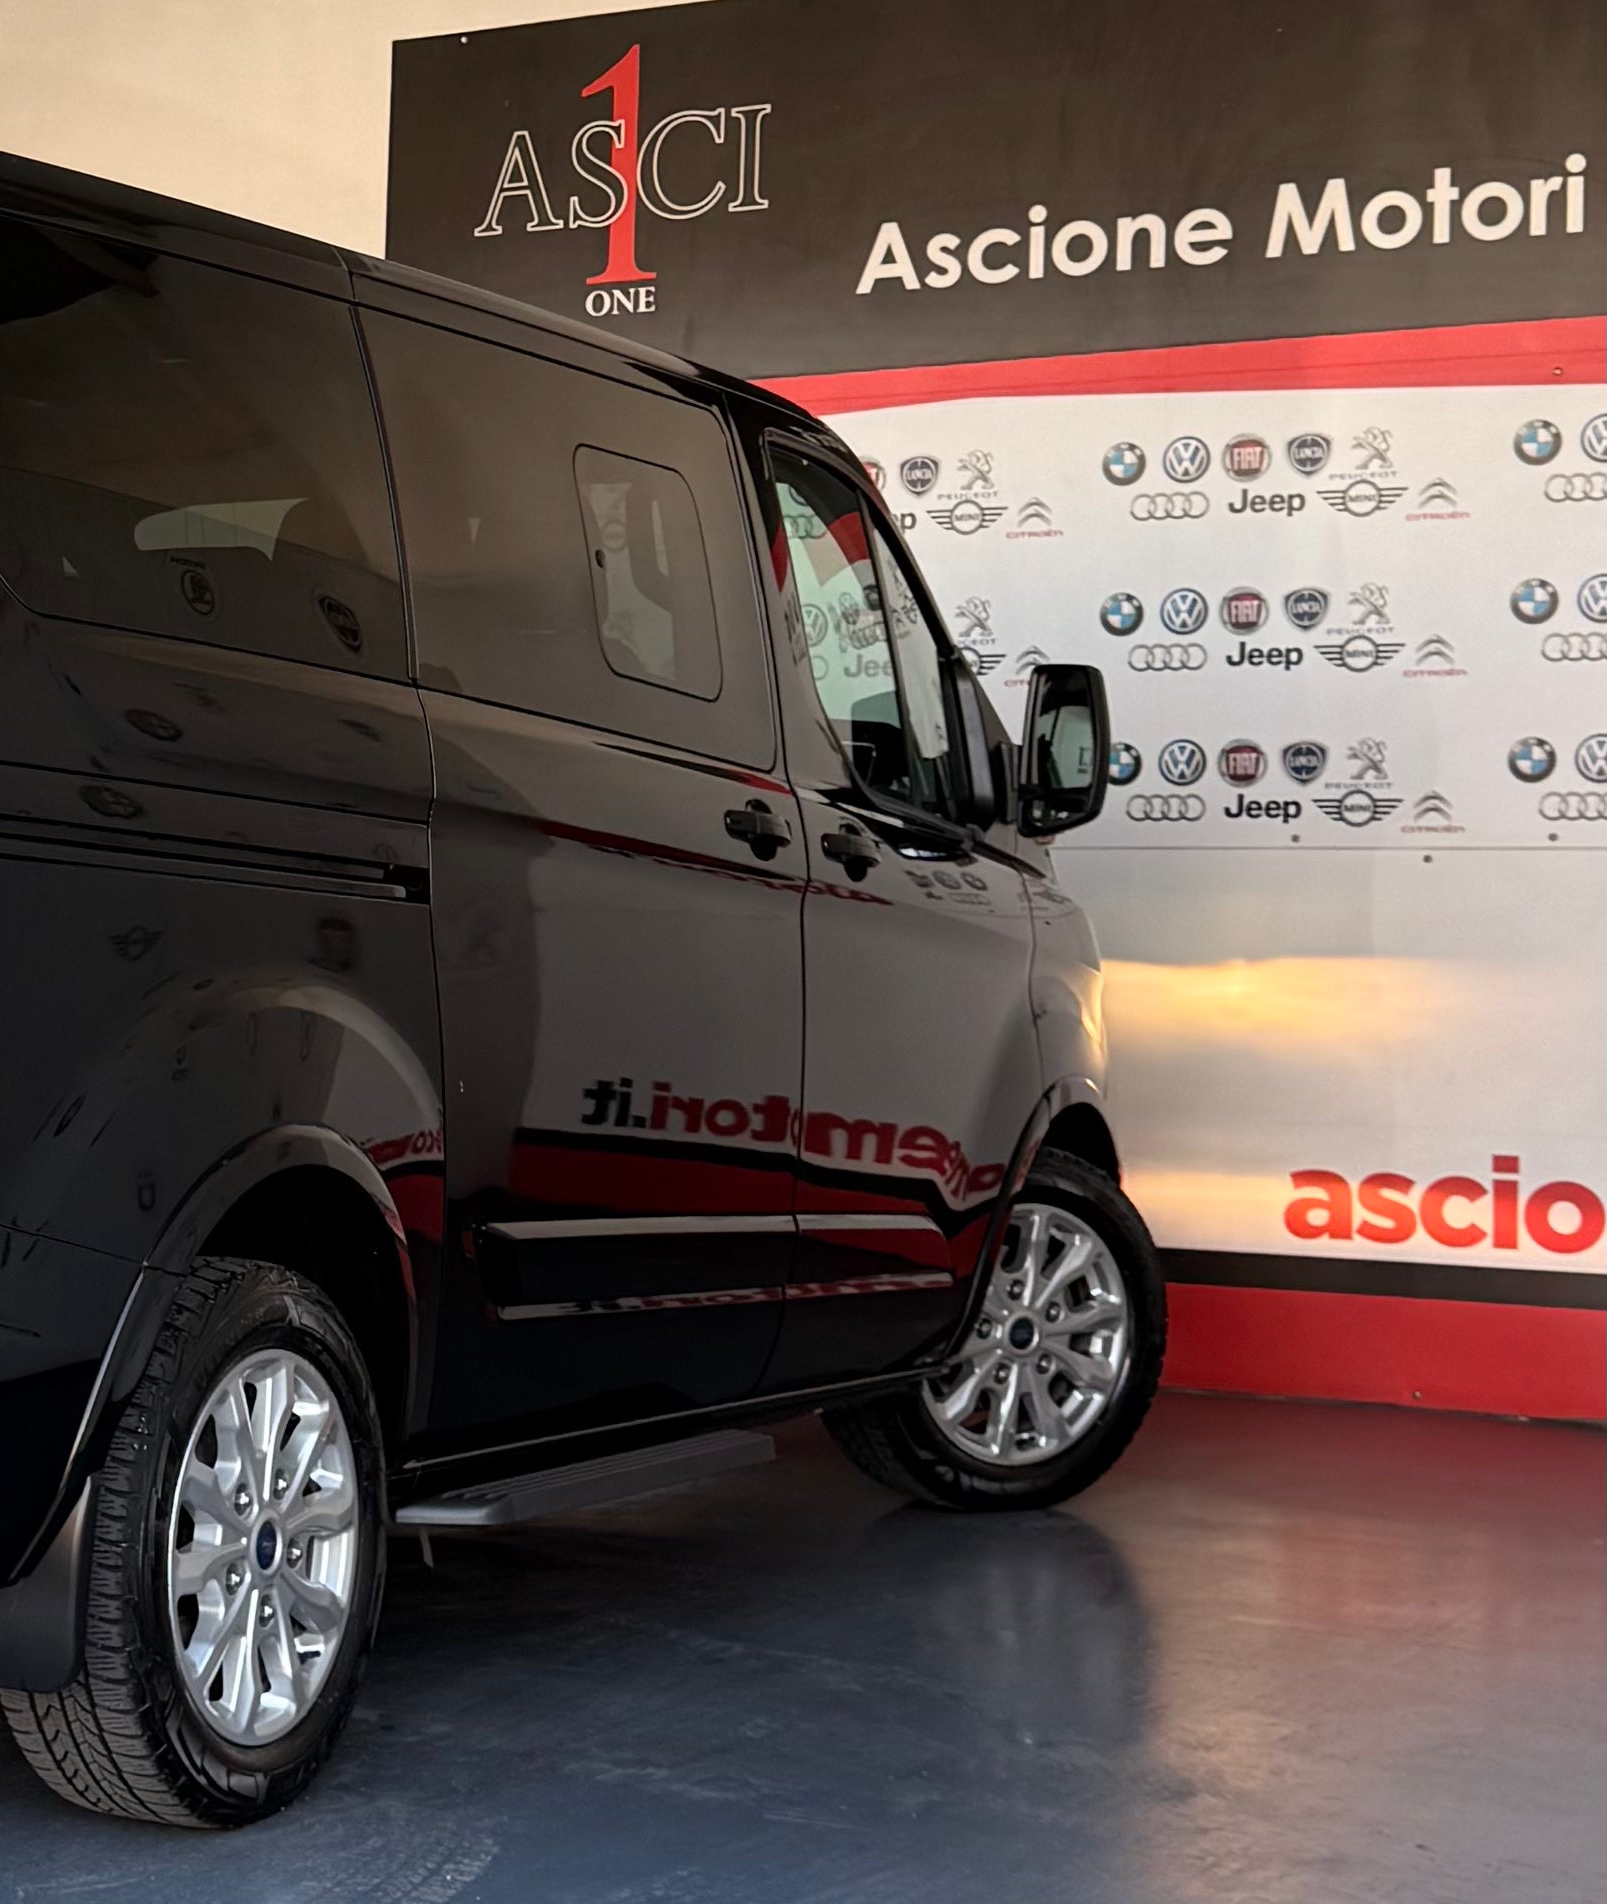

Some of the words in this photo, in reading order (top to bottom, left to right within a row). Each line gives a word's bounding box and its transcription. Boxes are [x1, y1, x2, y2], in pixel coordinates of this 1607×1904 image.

[474, 103, 773, 237] ASCI
[855, 204, 1234, 296] Ascione
[1265, 152, 1587, 259] Motori
[584, 286, 656, 317] ONE
[1231, 447, 1264, 472] FIAT
[1228, 488, 1306, 516] Jeep
[1229, 600, 1261, 624] FIAT
[844, 654, 892, 678] Jee
[1226, 641, 1303, 671] Jeep
[1227, 751, 1259, 775] FIAT
[1224, 793, 1302, 823] Jeep
[1283, 1153, 1606, 1255] ascio
